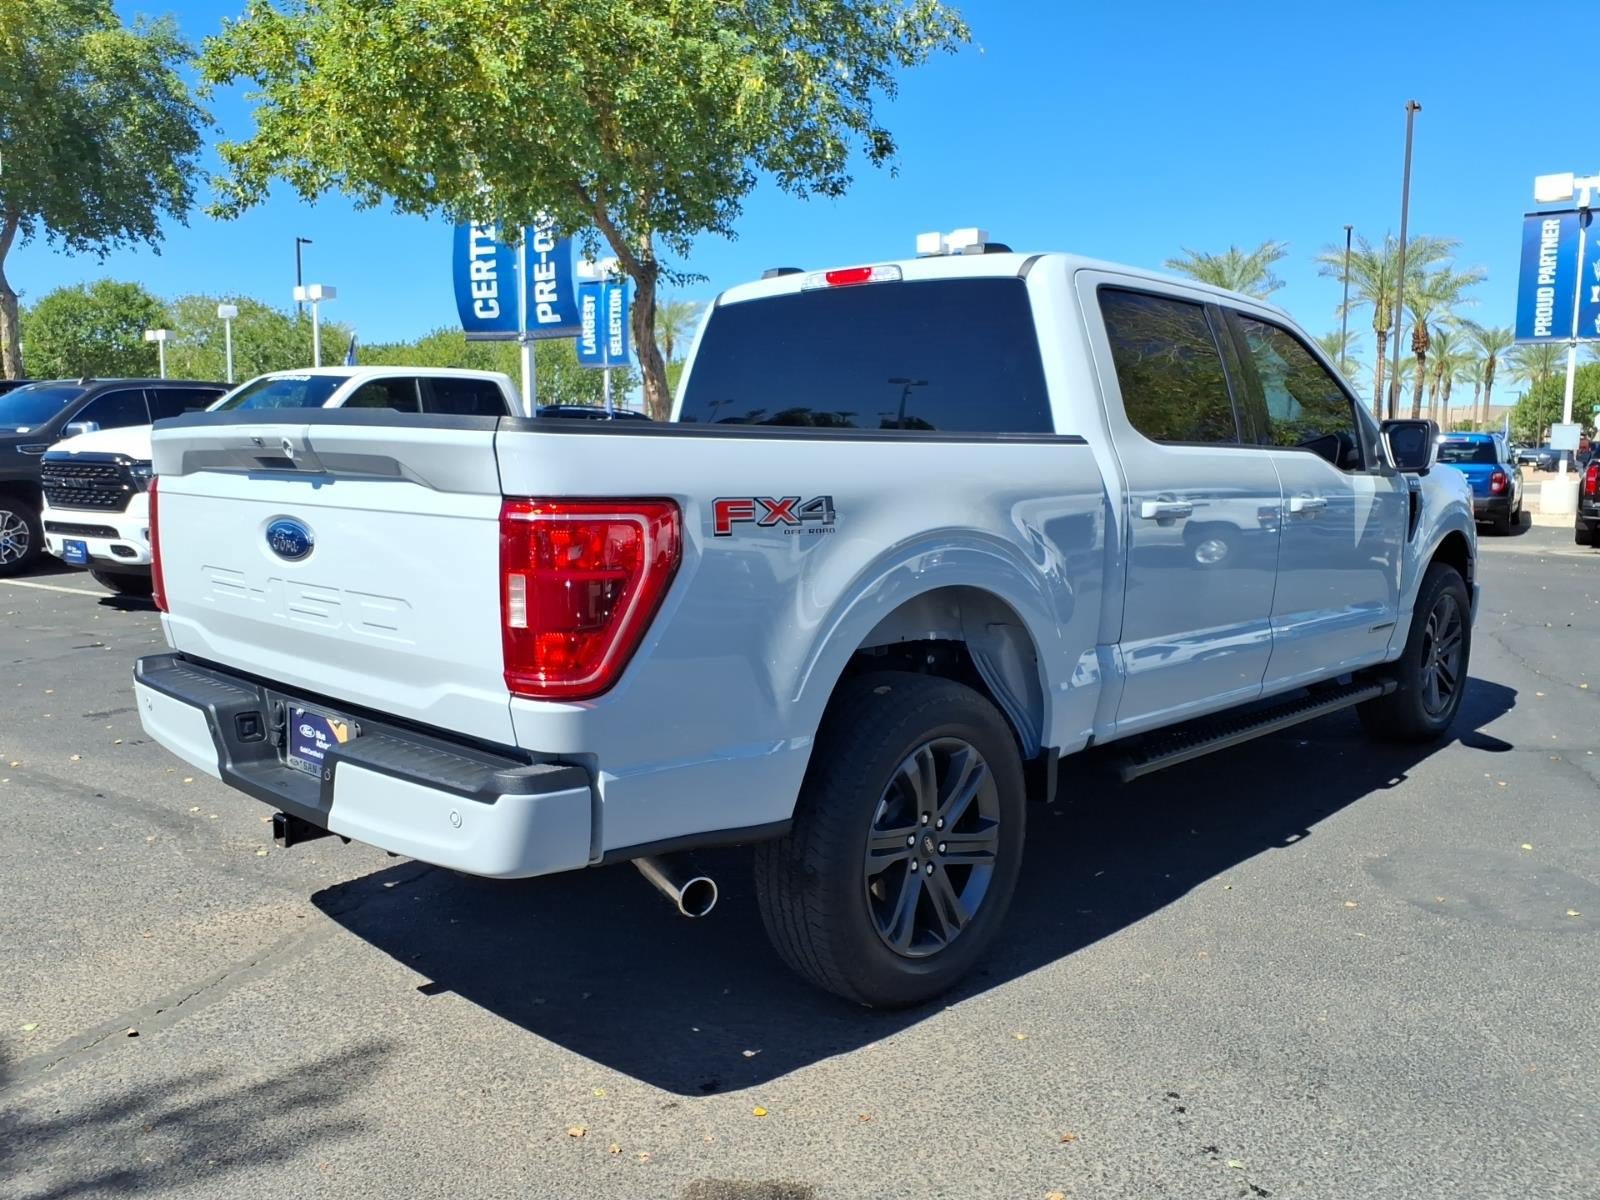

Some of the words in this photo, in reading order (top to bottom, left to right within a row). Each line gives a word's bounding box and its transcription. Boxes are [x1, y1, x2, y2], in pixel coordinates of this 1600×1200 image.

[1538, 219, 1561, 285] PARTNER
[583, 294, 597, 355] LARGEST
[609, 288, 623, 356] SELECTION
[1534, 287, 1555, 337] PROUD
[711, 495, 836, 536] FX4
[808, 527, 836, 535] ROAD
